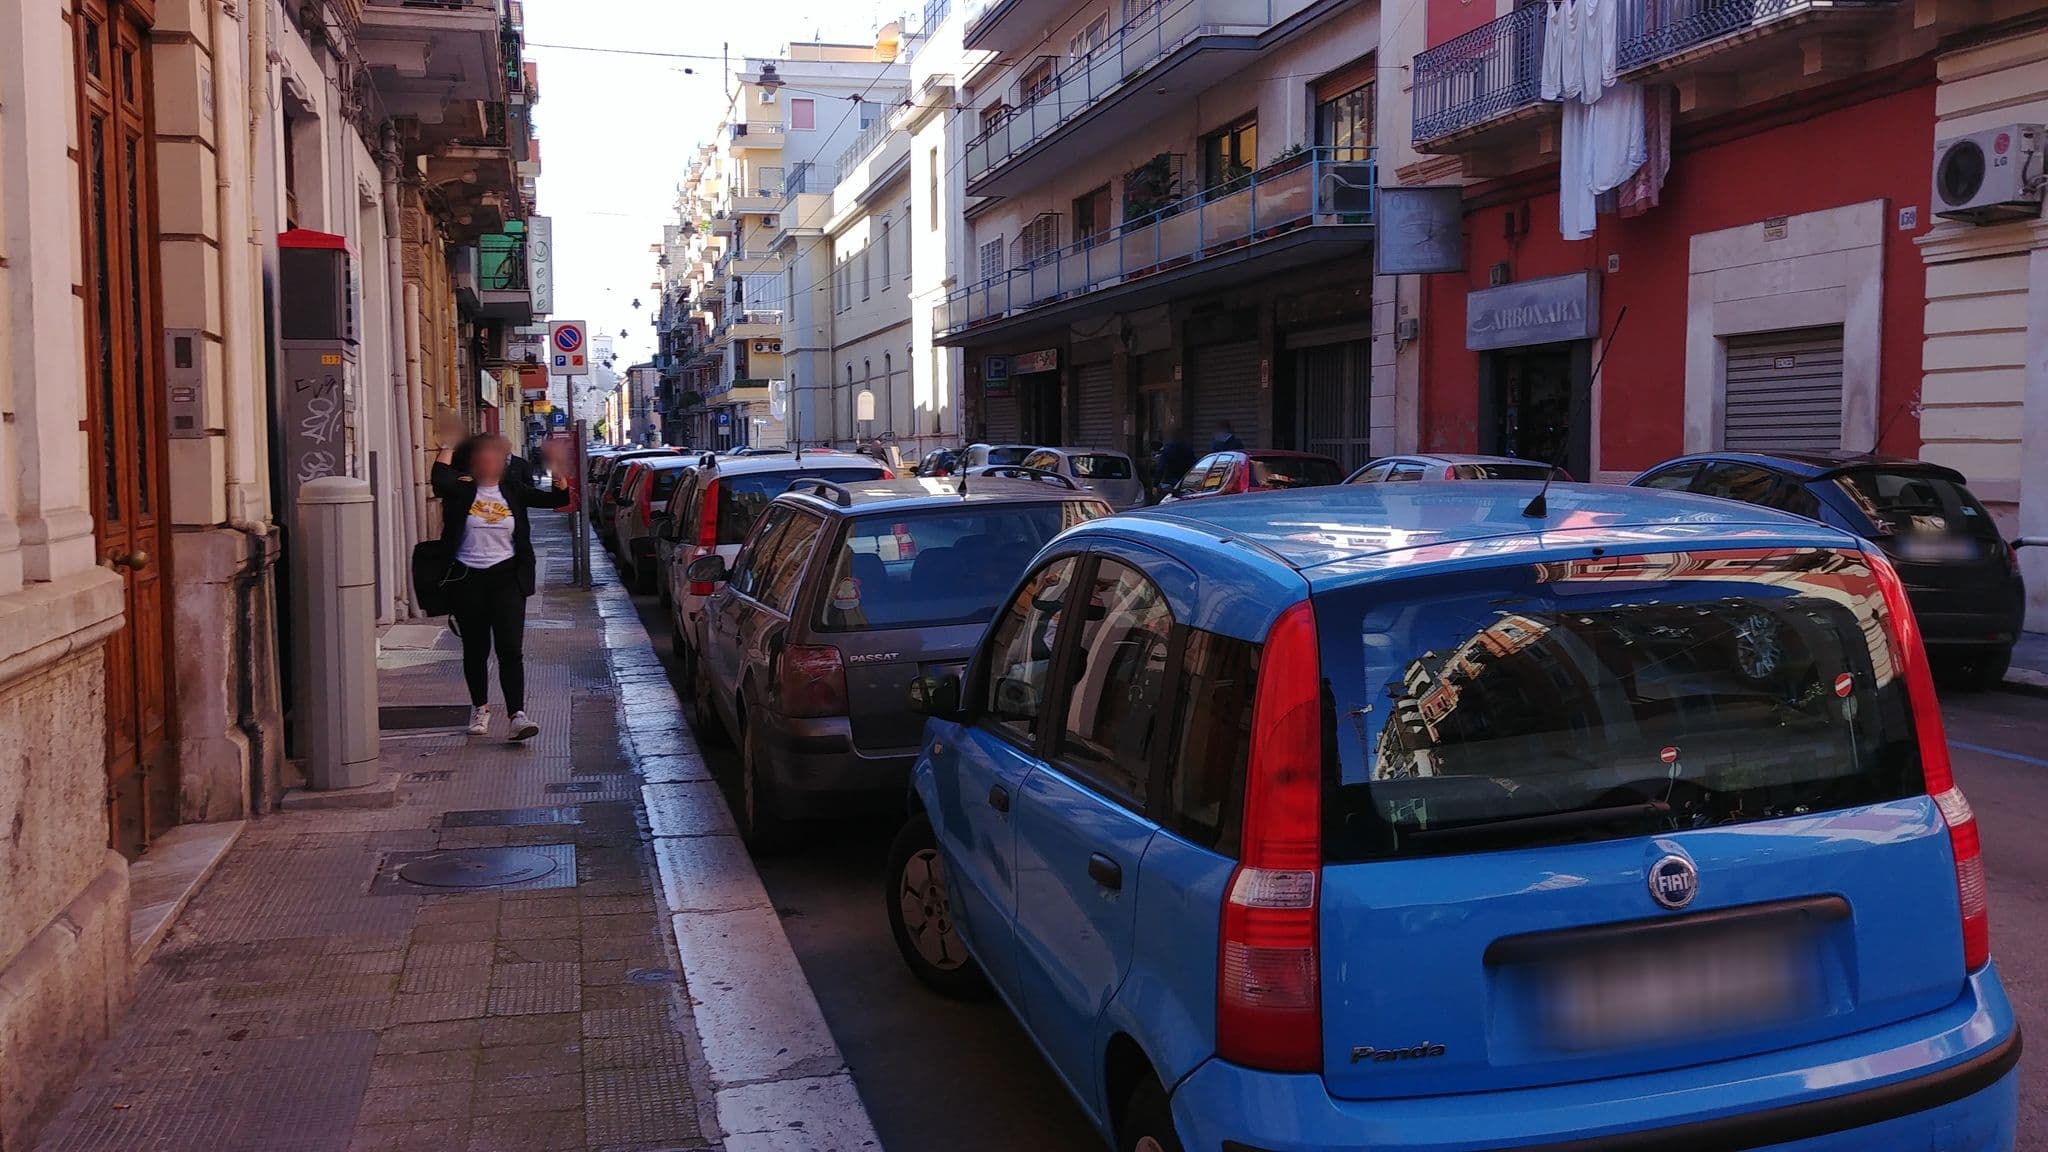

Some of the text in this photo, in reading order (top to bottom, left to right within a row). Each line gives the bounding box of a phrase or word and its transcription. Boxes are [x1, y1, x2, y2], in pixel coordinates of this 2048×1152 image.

[1994, 156, 2008, 168] LG
[557, 356, 565, 364] P
[991, 358, 1004, 377] P
[555, 414, 563, 423] P
[720, 414, 727, 424] P
[850, 652, 900, 663] PASSAT
[1658, 872, 1690, 893] FIAT
[1350, 1040, 1446, 1064] Panda
